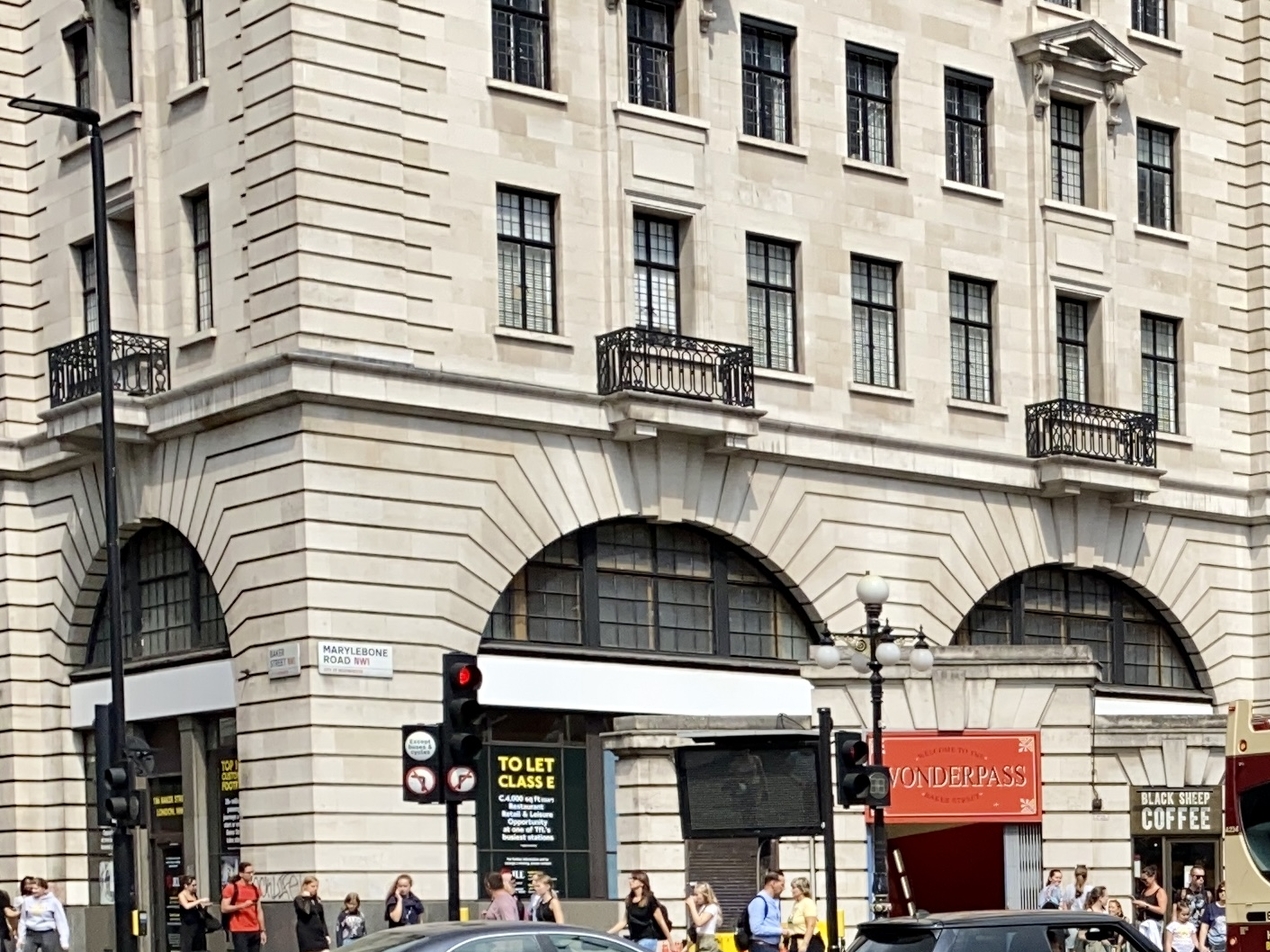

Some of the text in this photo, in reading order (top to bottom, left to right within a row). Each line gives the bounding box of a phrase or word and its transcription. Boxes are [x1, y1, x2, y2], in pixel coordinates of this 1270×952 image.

[323, 645, 388, 657] MARYLEBONE
[324, 655, 370, 666] ROAD NW1
[498, 756, 555, 772] TO LET
[221, 772, 238, 780] CUSTO
[498, 774, 555, 789] CLASS E
[1141, 792, 1210, 805] BLACK SHEEP
[508, 802, 544, 810] Restaurant
[501, 810, 521, 818] Retail
[1142, 806, 1210, 830] COFFEE
[507, 818, 548, 826] Opportunity
[502, 826, 510, 834] at
[526, 826, 533, 834] of
